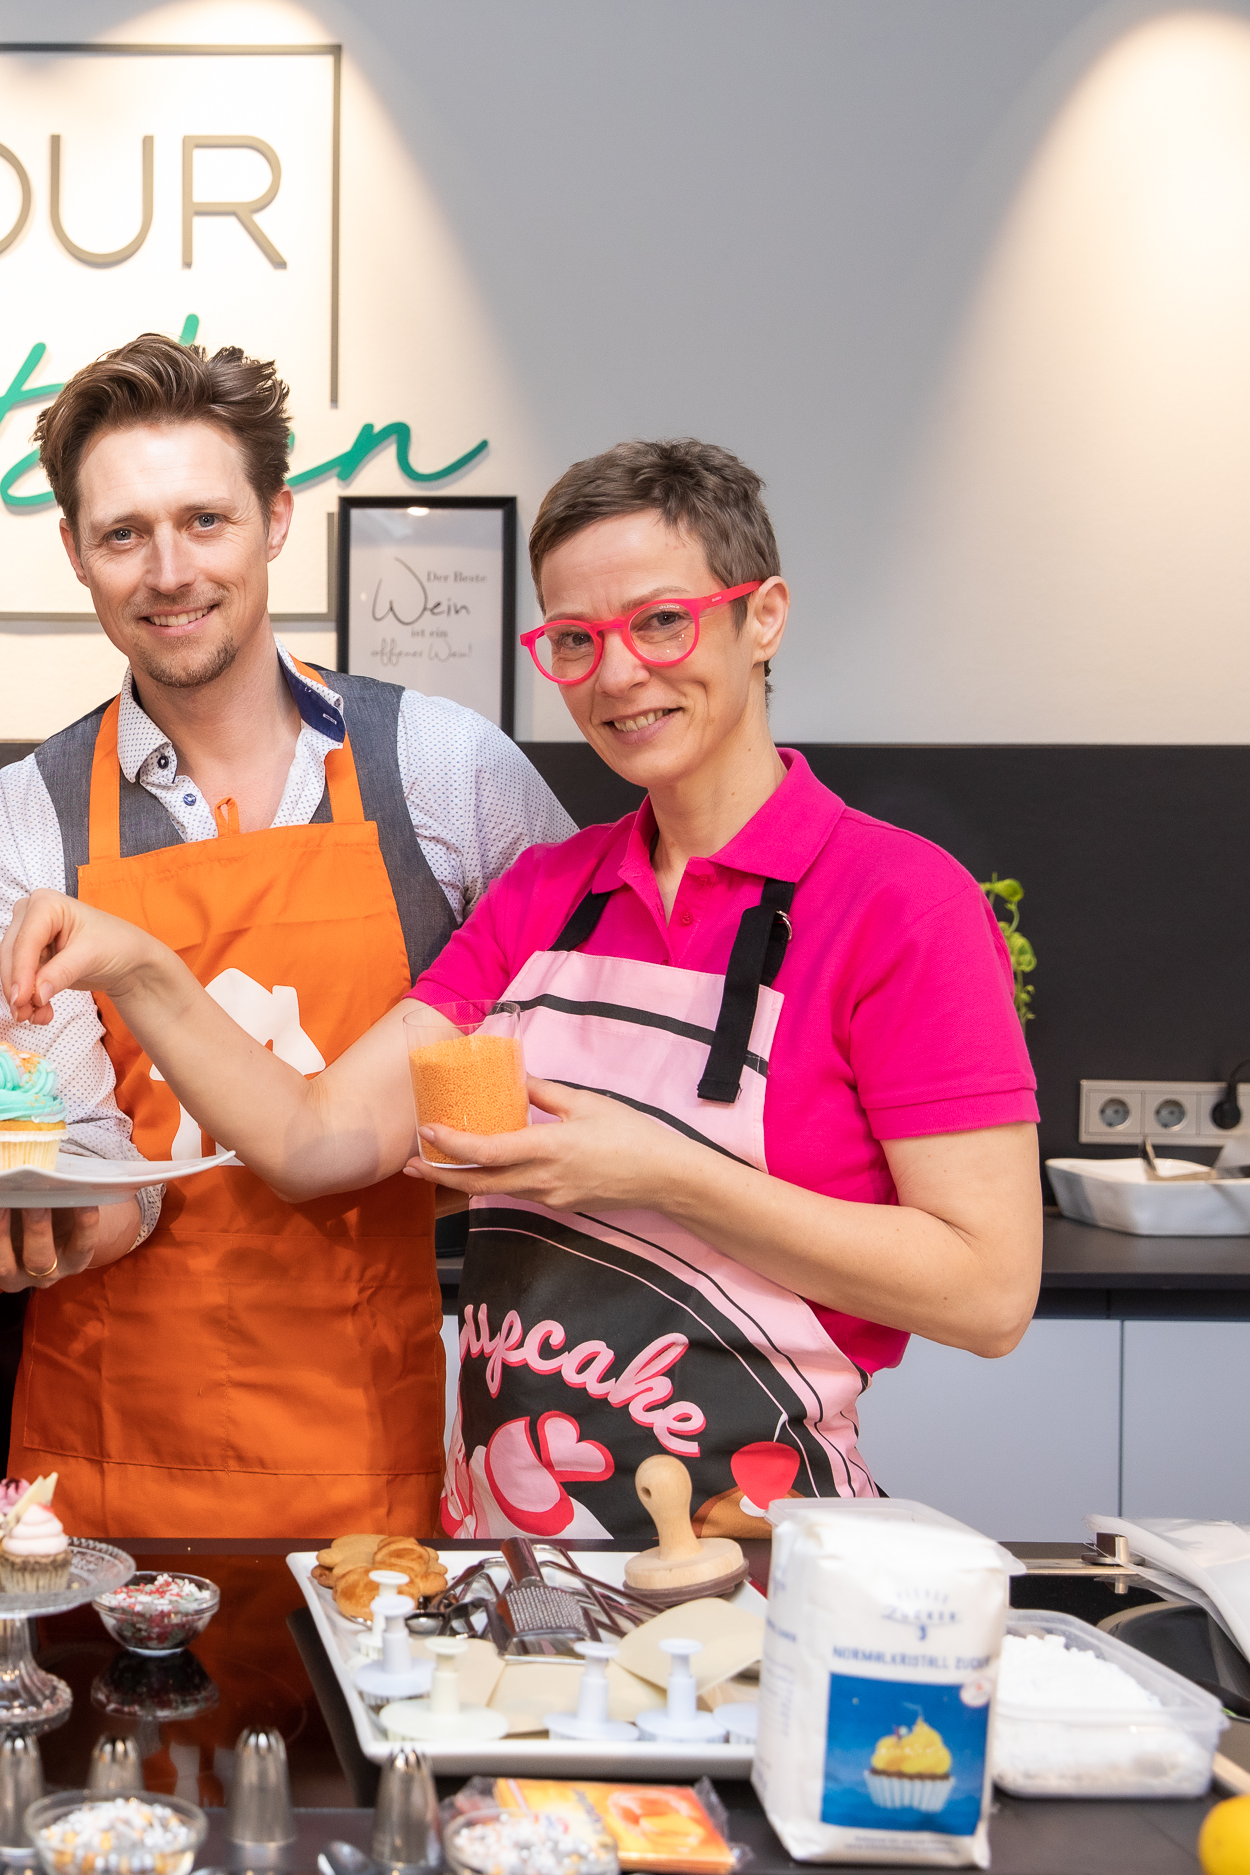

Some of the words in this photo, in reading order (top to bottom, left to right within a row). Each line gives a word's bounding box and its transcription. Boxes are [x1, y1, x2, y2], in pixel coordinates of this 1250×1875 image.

[371, 556, 471, 626] Wein
[426, 571, 449, 582] Der
[453, 571, 487, 583] Beste
[410, 629, 426, 638] ist
[459, 1303, 707, 1457] upcake
